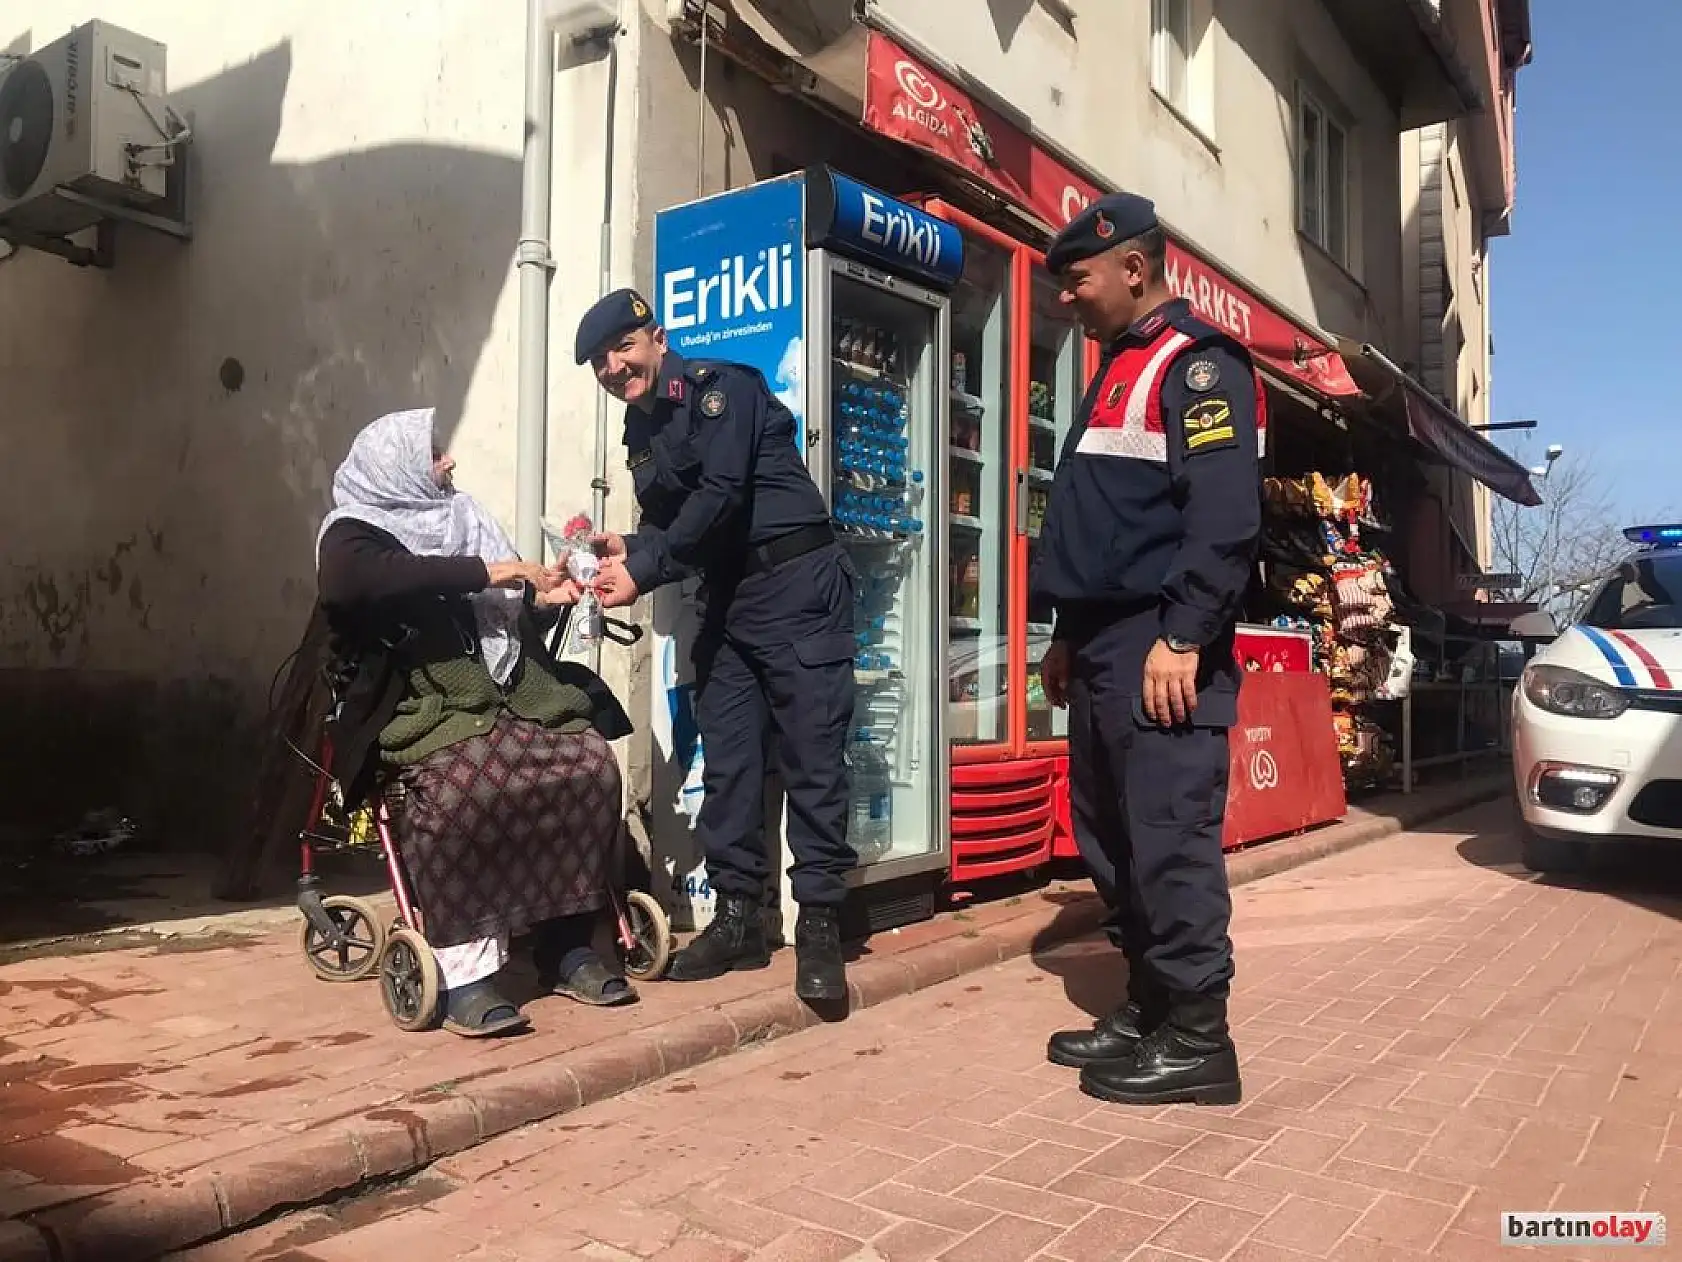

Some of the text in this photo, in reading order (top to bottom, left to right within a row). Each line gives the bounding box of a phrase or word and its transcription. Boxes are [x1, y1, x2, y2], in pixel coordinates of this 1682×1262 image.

[862, 191, 940, 267] Erikli
[663, 242, 792, 330] Erikli
[1164, 256, 1251, 341] MARKET
